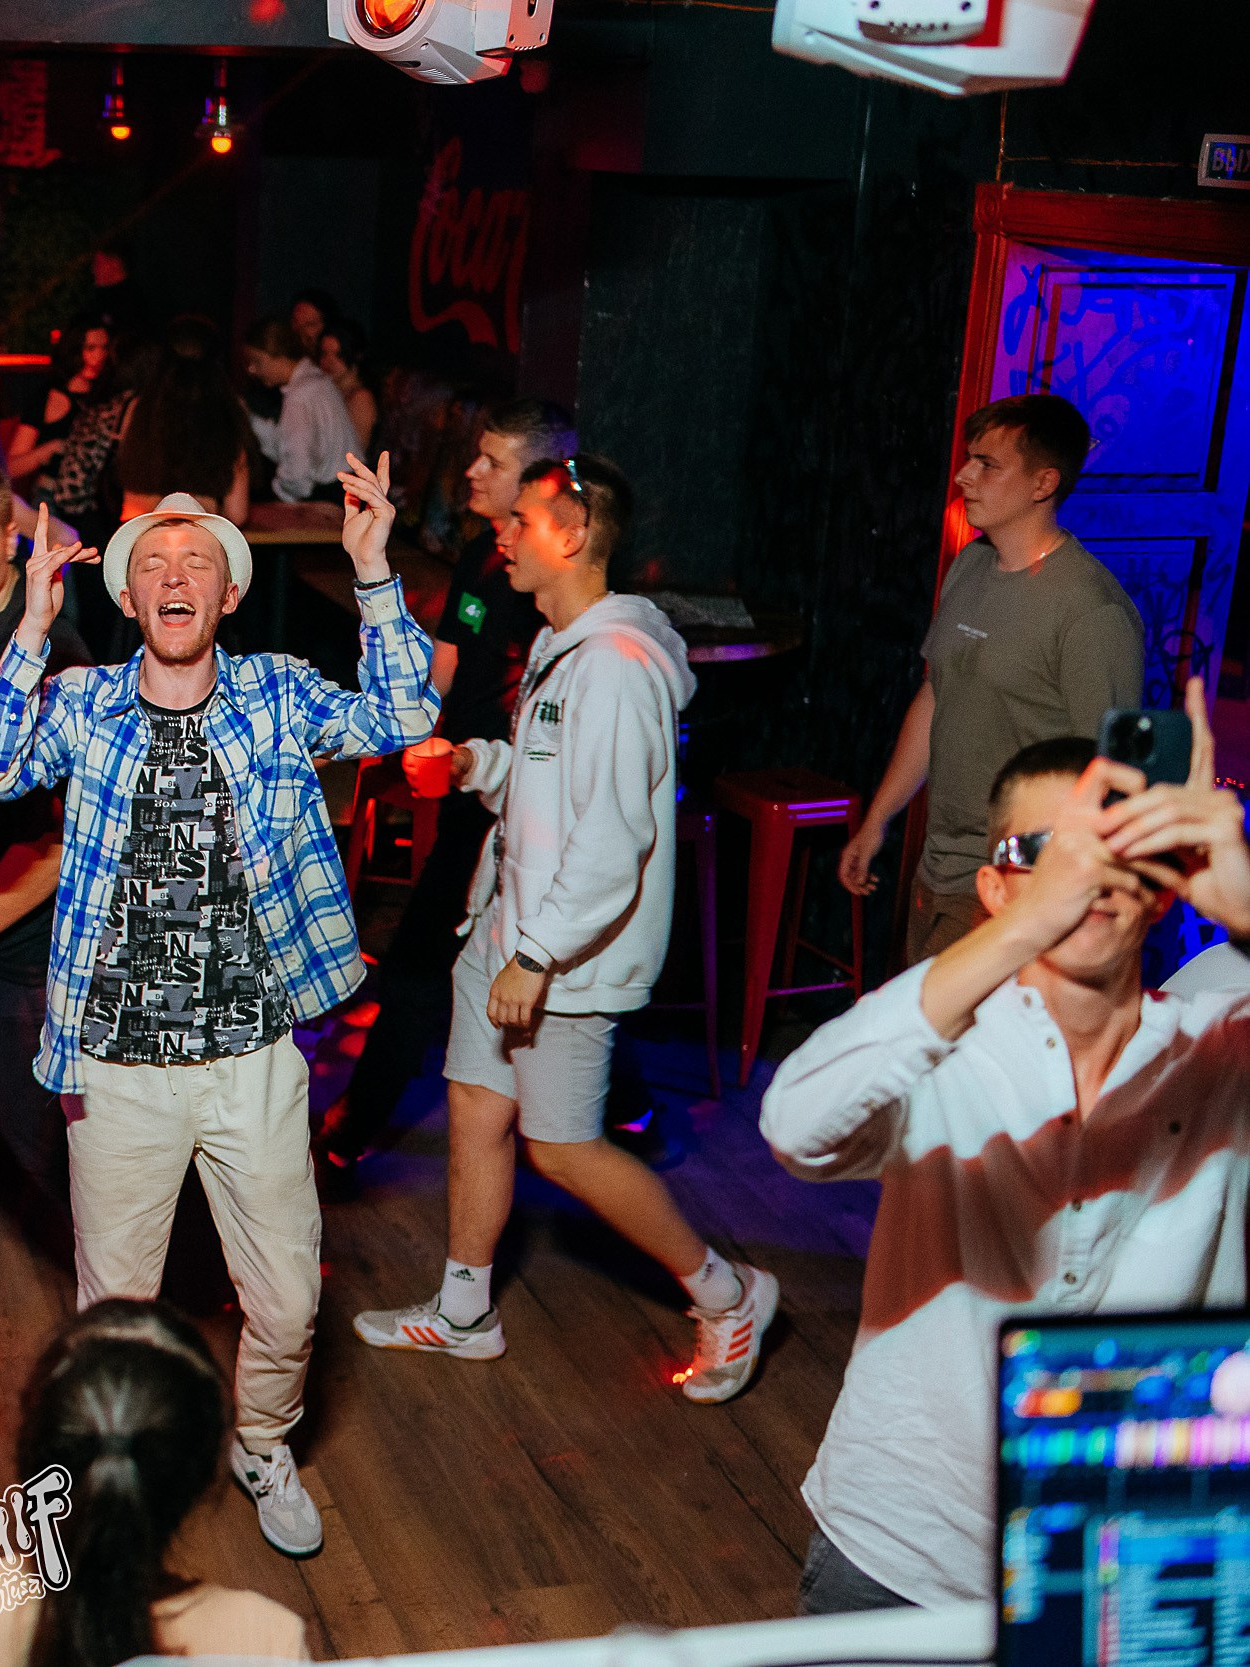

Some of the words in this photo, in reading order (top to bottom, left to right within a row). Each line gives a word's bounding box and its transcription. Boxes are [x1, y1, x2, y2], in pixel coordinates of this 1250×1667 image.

[184, 736, 210, 766] S
[171, 822, 199, 851] N
[177, 850, 207, 879] S
[166, 931, 195, 959] N
[173, 957, 202, 984] S
[159, 1031, 188, 1055] N
